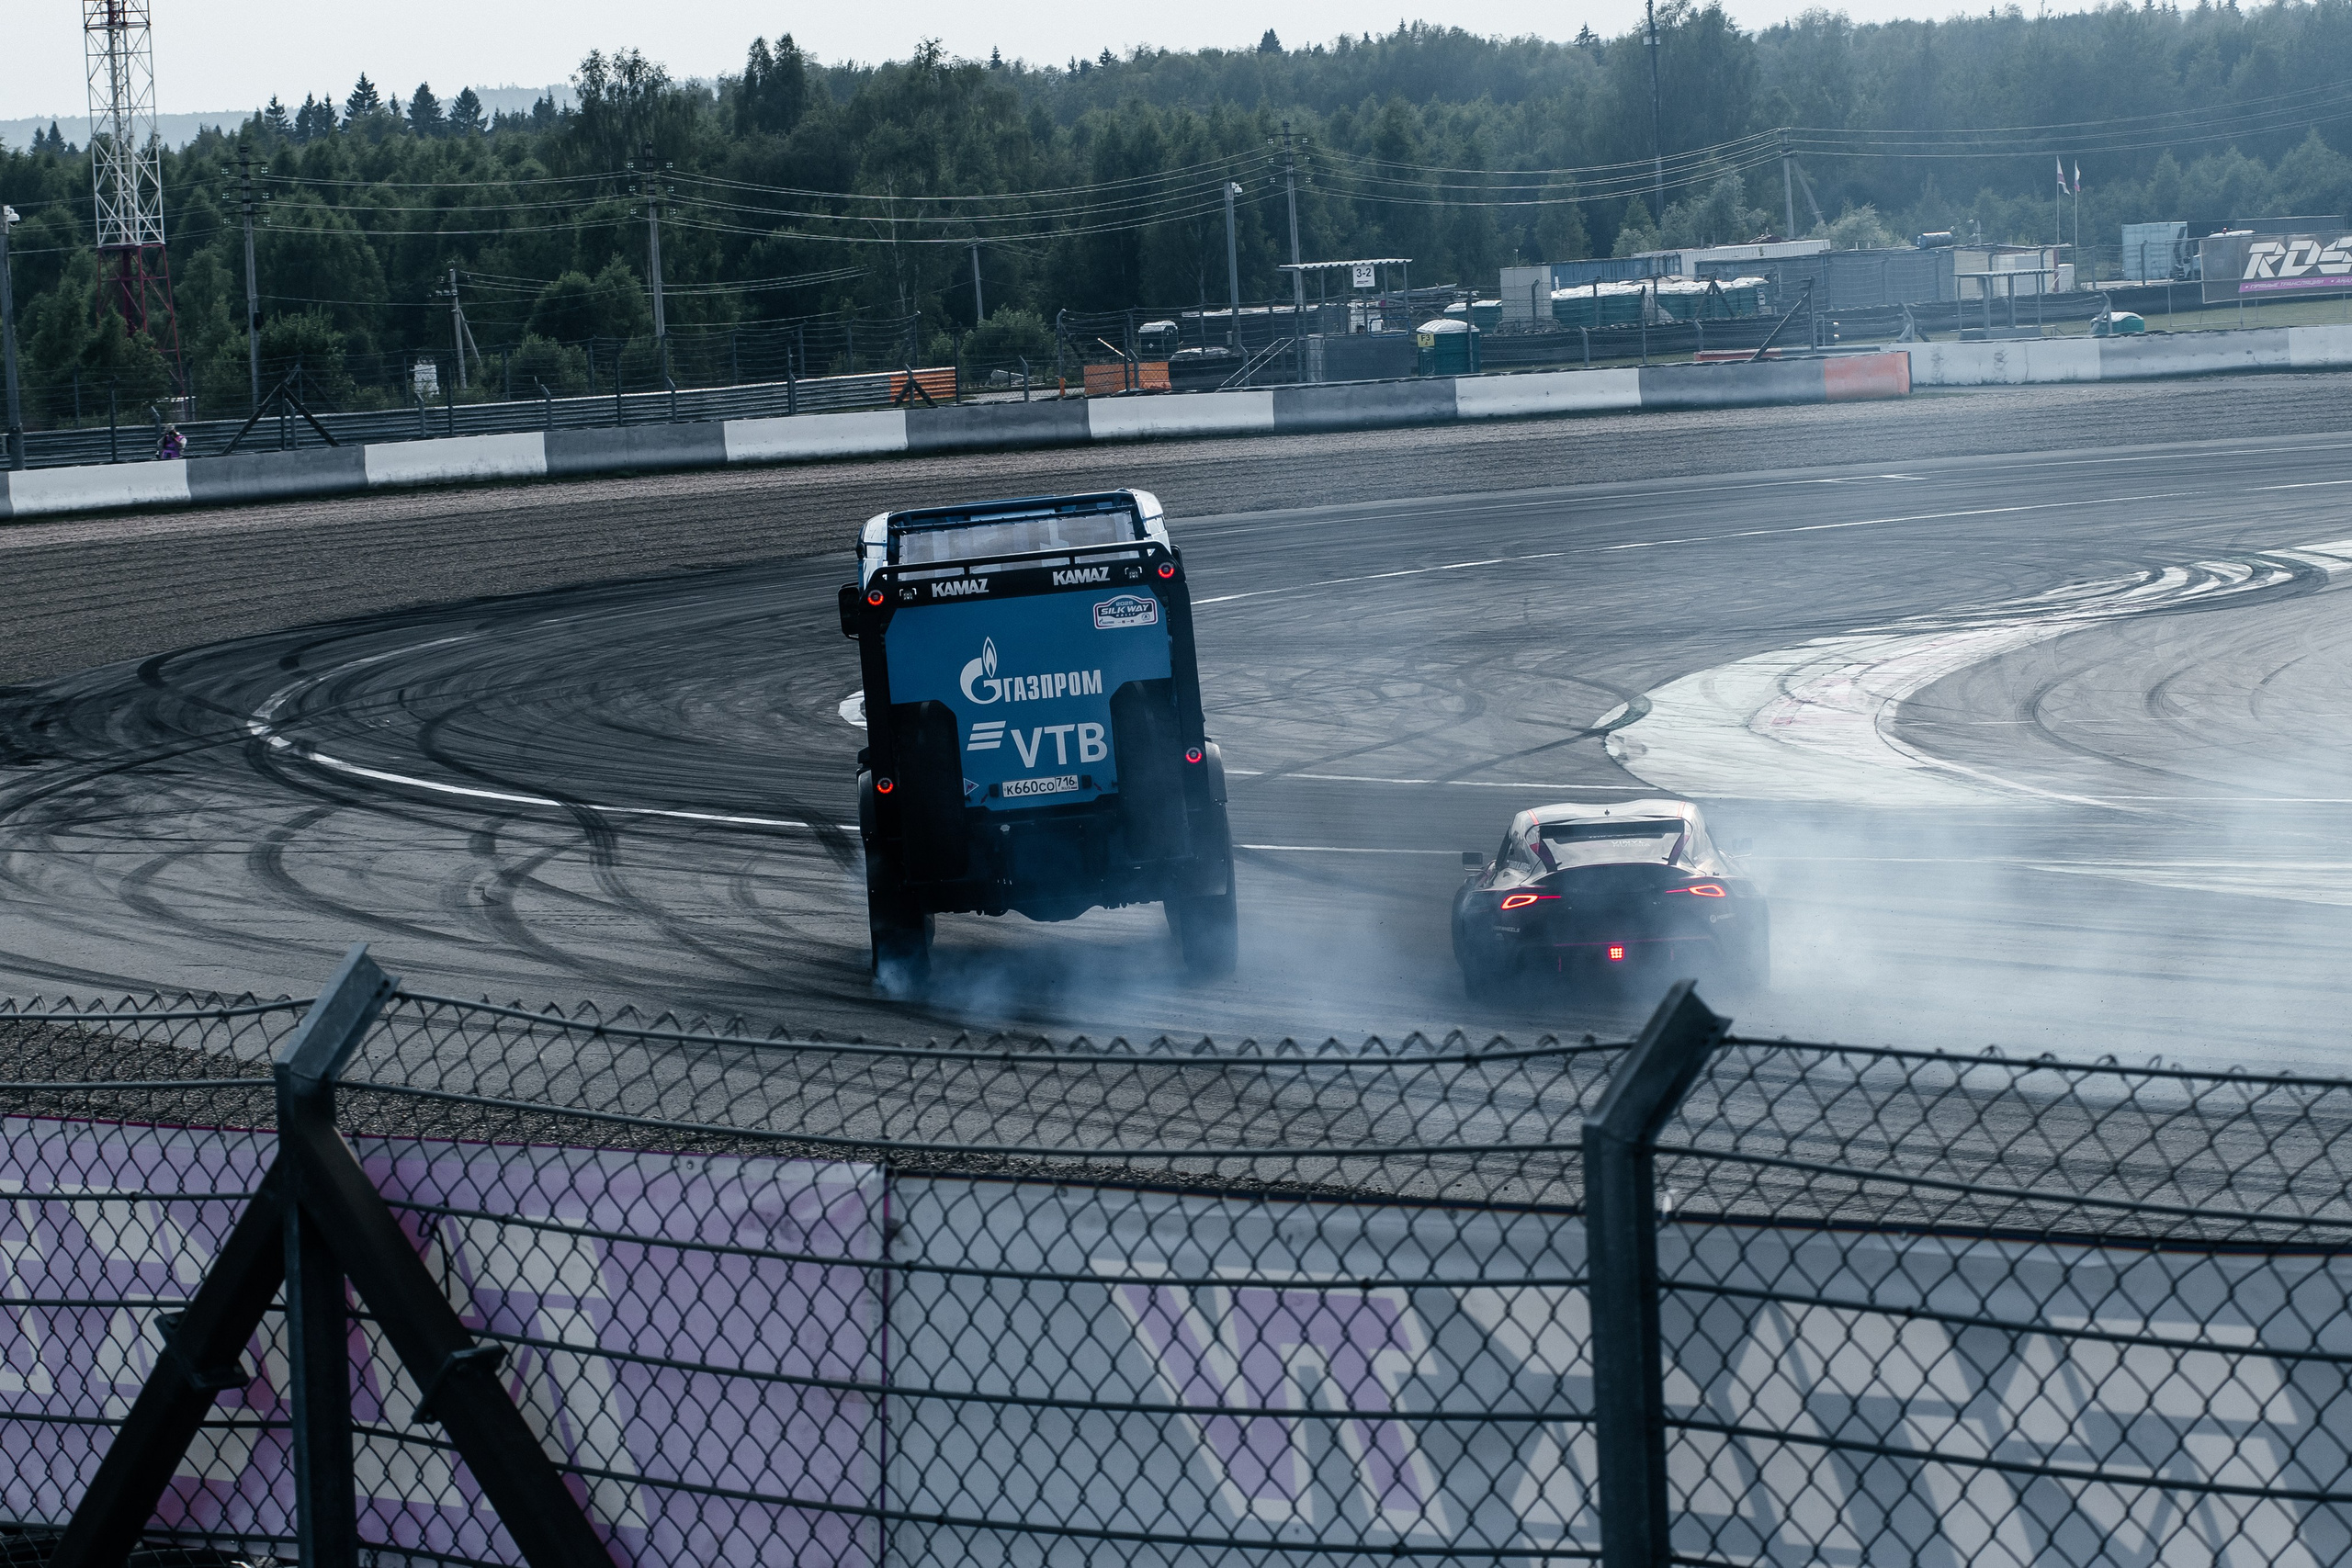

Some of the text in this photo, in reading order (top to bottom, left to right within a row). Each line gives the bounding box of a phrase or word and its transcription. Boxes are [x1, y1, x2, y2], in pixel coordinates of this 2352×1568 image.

[2243, 235, 2352, 279] RDS
[1356, 267, 1372, 277] 3-2
[1053, 567, 1110, 586] KAMAZ
[932, 579, 989, 597] KAMAZ
[1101, 604, 1149, 615] SILK WAY
[1003, 669, 1102, 703] ГАЗПРОМ
[1011, 722, 1108, 768] VTB
[1057, 776, 1075, 787] 716
